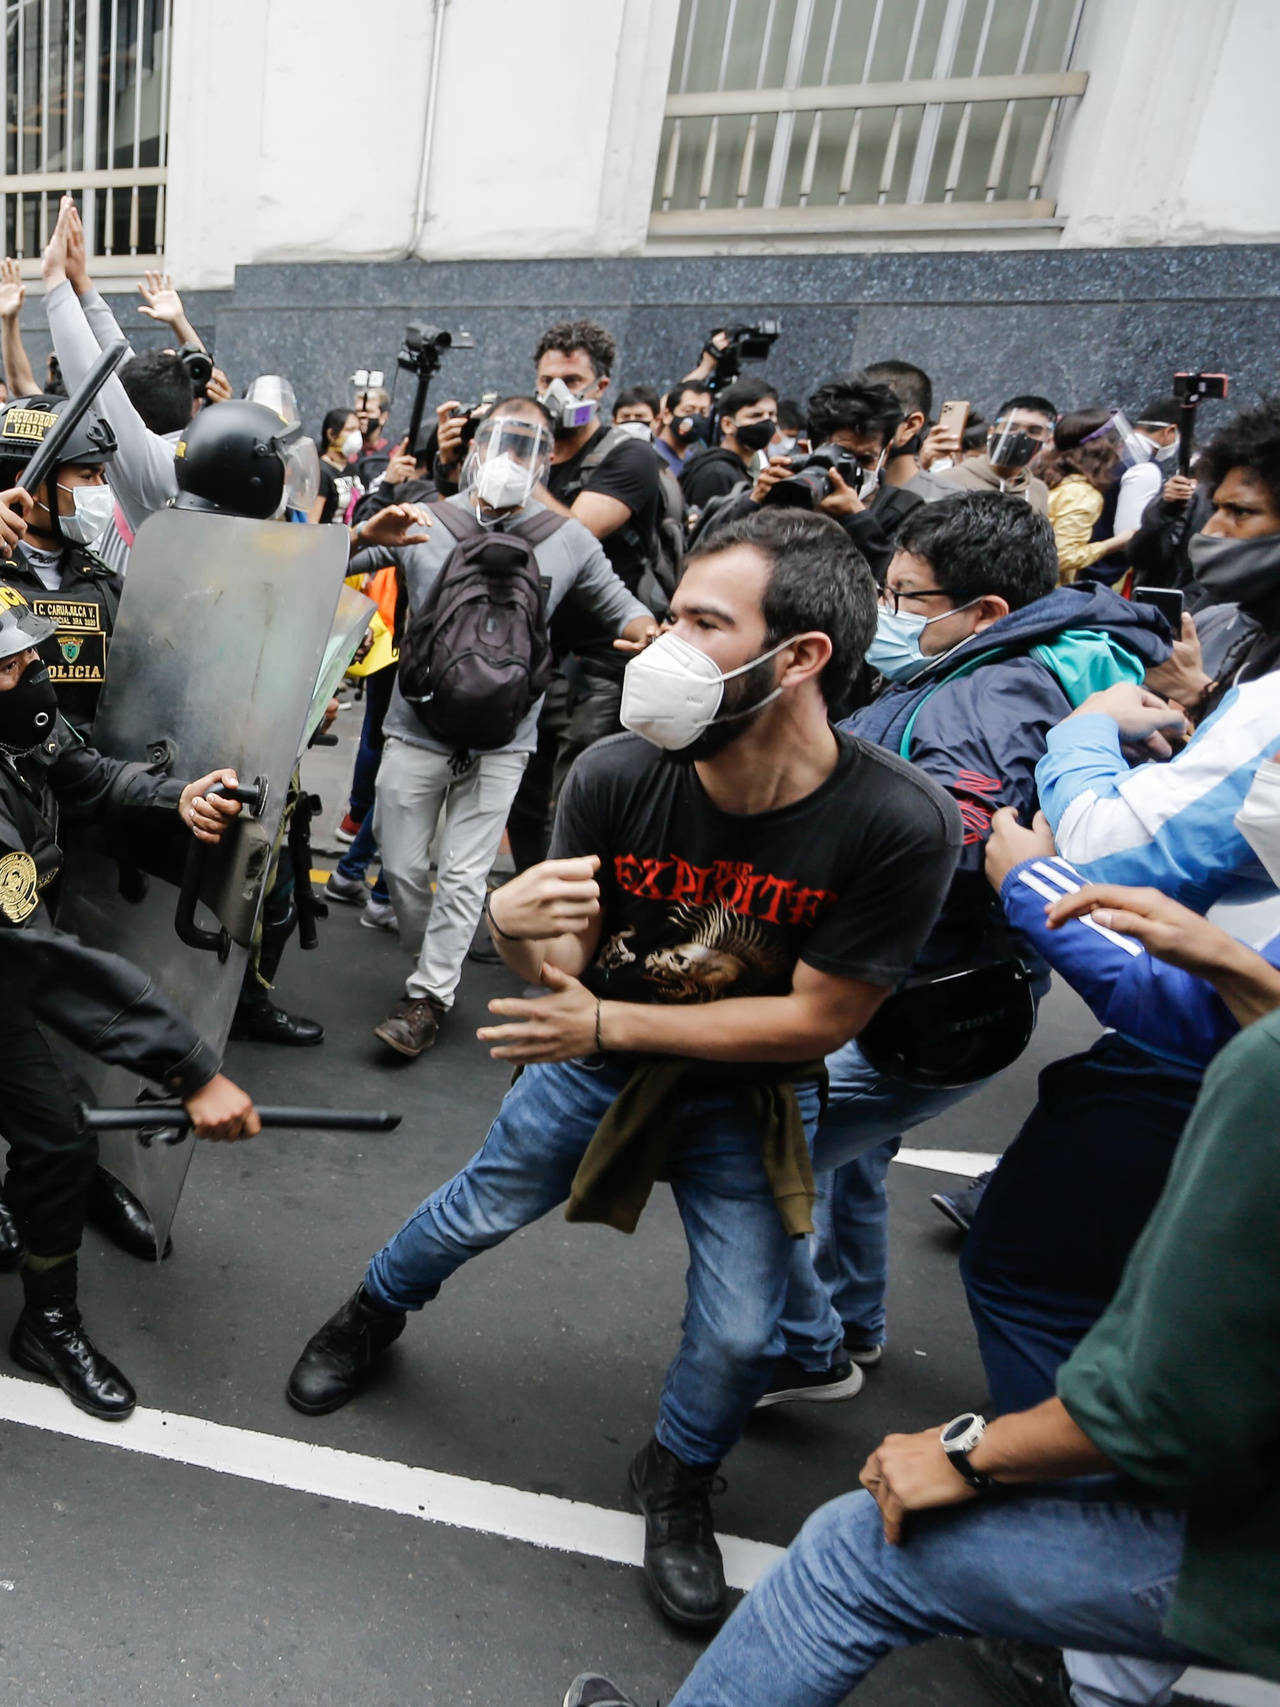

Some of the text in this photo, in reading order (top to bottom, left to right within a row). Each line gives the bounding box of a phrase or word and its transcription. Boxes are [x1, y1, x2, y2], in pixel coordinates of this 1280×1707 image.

[8, 412, 57, 428] ESCUADRON
[14, 423, 44, 437] VERDE
[38, 603, 46, 615] C.
[88, 607, 95, 618] V.
[47, 665, 101, 678] OLICIA
